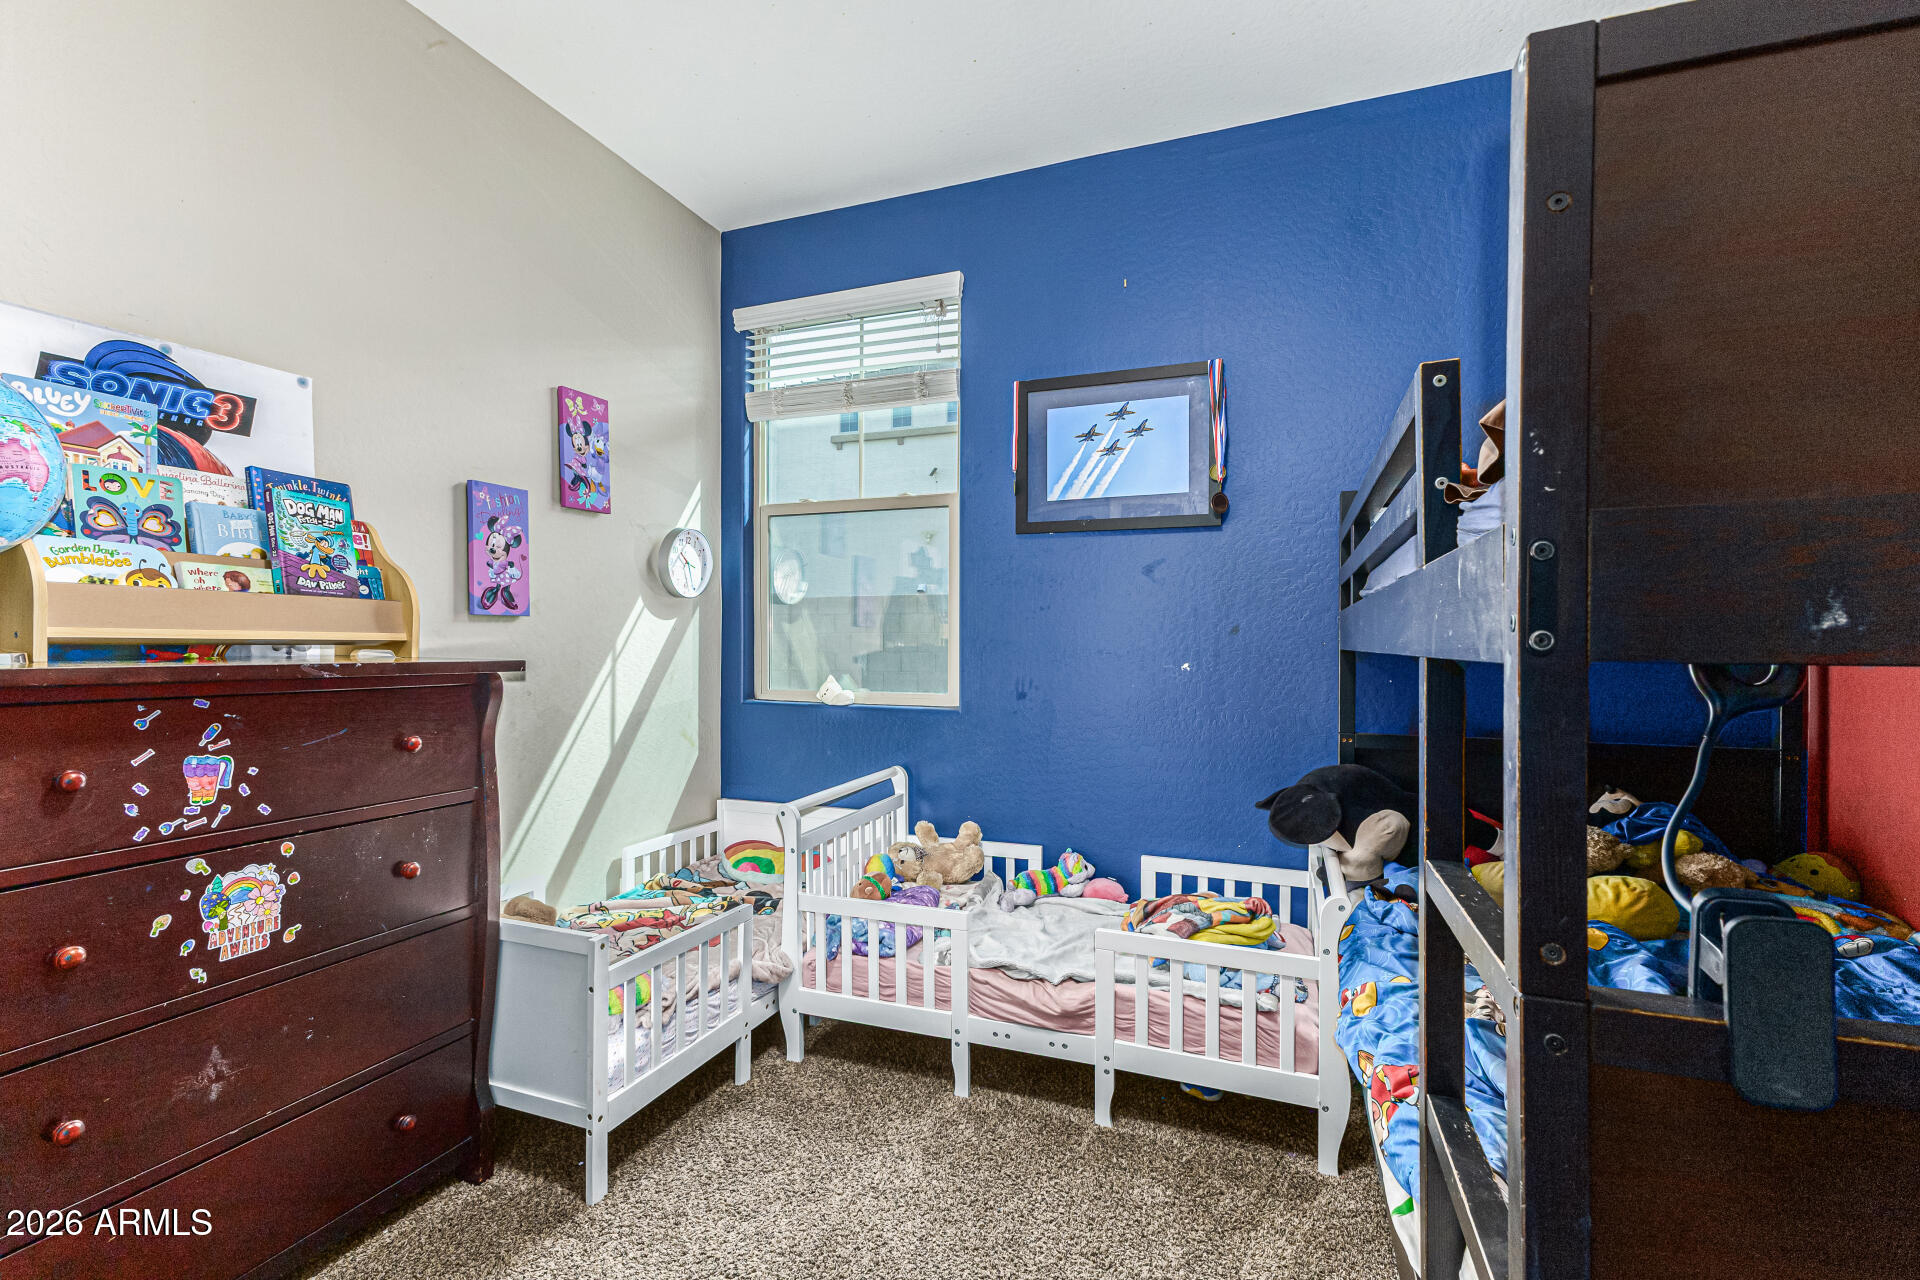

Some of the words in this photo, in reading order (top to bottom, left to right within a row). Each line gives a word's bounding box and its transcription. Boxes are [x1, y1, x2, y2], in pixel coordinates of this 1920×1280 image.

[10, 380, 91, 417] BLUEY
[42, 361, 214, 418] SONIC
[207, 392, 245, 431] 3
[81, 469, 175, 502] LOVE
[200, 474, 246, 491] Ballerina
[283, 499, 315, 518] DOG
[317, 504, 345, 525] MAN
[43, 553, 132, 568] Bumblebee
[50, 544, 91, 555] Garden
[93, 544, 120, 557] Days
[297, 577, 318, 588] DAV
[209, 916, 279, 949] ADVENTURE
[220, 933, 269, 961] AWAITS
